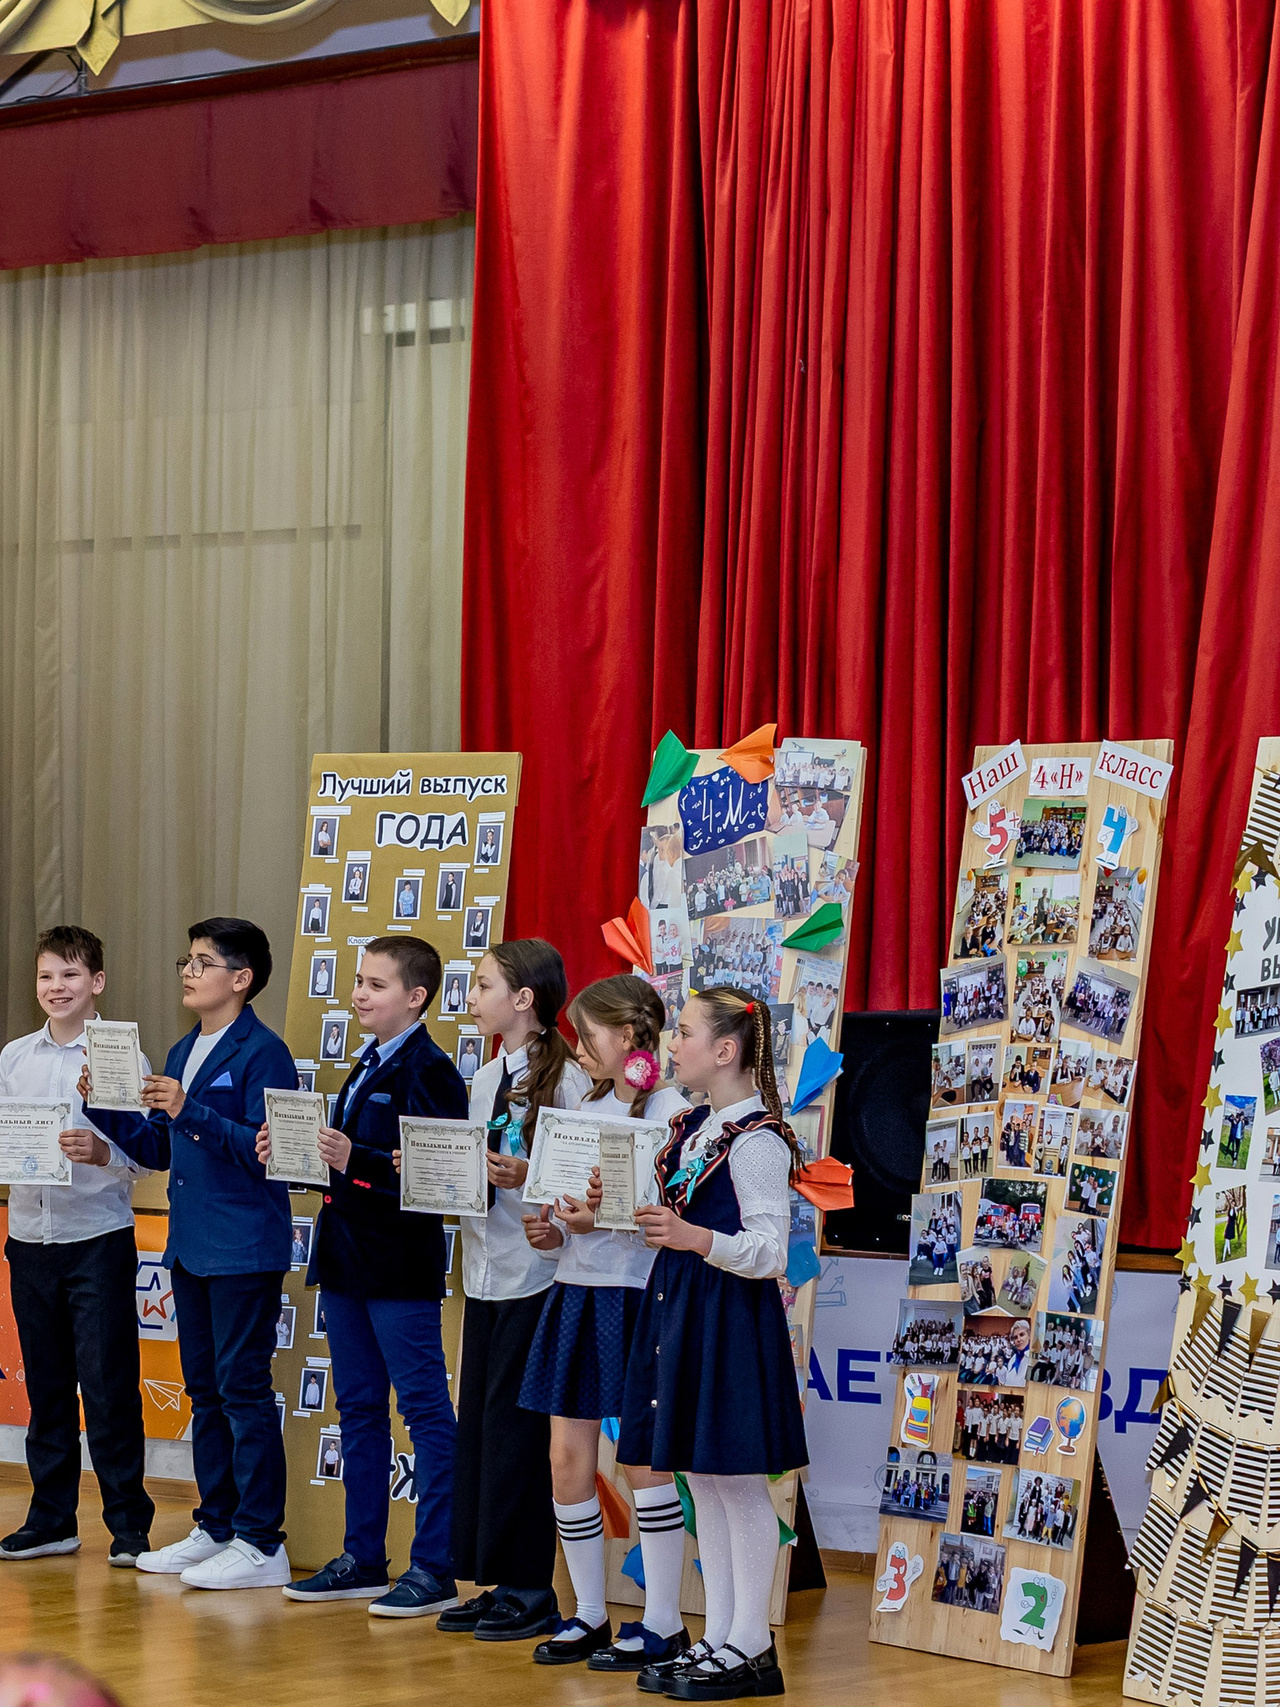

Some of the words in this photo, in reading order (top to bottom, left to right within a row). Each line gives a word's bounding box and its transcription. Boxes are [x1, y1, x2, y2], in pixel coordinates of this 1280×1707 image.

[319, 771, 411, 802] Лучший
[420, 777, 506, 801] выпуск
[966, 751, 1019, 800] Наш
[1033, 763, 1084, 790] 4«Н»
[1099, 751, 1163, 790] класс
[377, 813, 467, 850] ГОДА
[411, 1140, 453, 1149] Похвальный
[554, 1132, 600, 1143] Похваль
[885, 1554, 907, 1601] 3
[1019, 1581, 1047, 1630] 2
